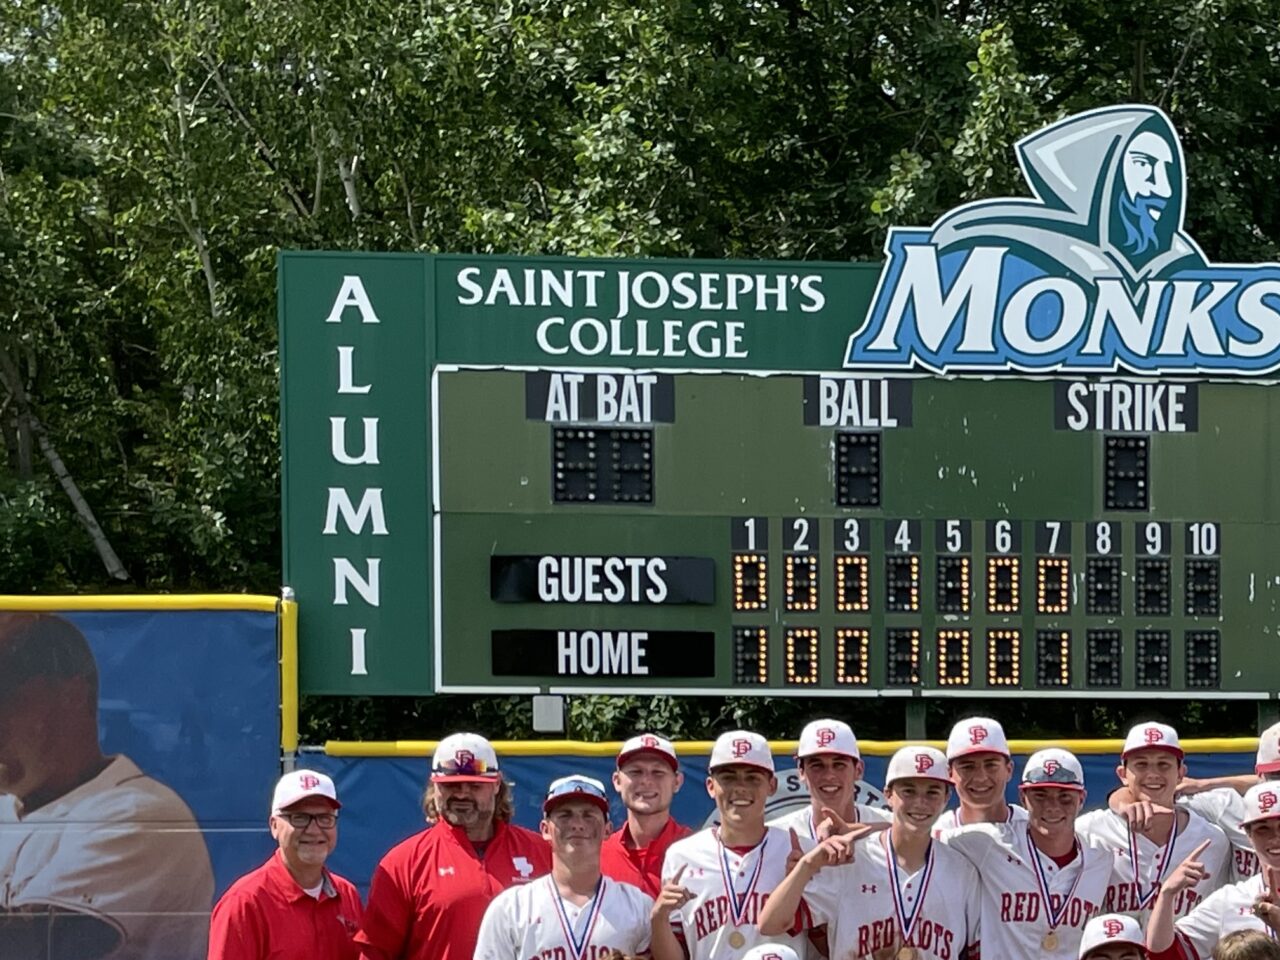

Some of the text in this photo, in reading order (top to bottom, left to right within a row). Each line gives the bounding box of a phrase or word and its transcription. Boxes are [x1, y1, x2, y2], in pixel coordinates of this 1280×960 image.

[456, 267, 825, 318] SAINT JOSEPH'S
[537, 317, 748, 358] COLLEGE
[545, 374, 657, 423] AT BAT
[820, 379, 897, 428] BALL
[1067, 382, 1186, 432] STRIKE
[323, 276, 388, 675] ALUMNI
[745, 518, 1216, 555] 1 2 3 4 5 6 7 8 9 10
[538, 556, 668, 603] GUESTS
[837, 557, 868, 610] 0
[988, 559, 1019, 612] 0
[1037, 559, 1068, 612] 0
[558, 630, 649, 675] HOME
[837, 630, 868, 683] 0
[939, 630, 970, 684] 0
[988, 631, 1019, 685] 0
[694, 895, 728, 941] RED
[1001, 892, 1040, 922] RED
[858, 917, 894, 958] RED
